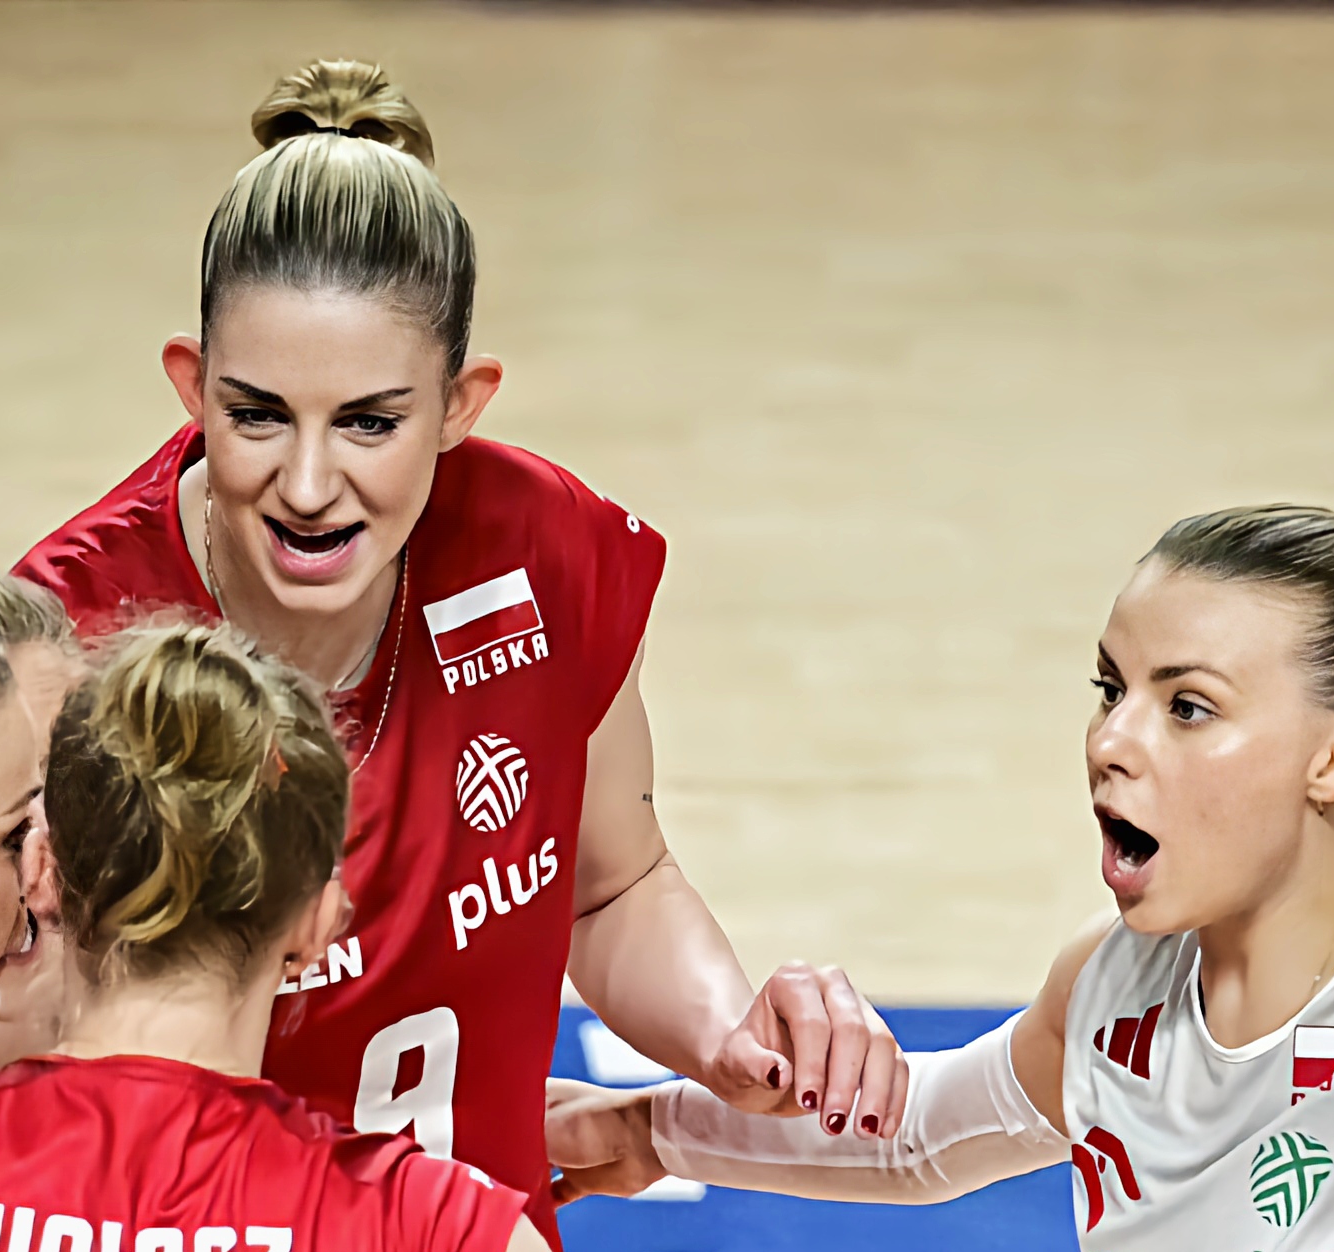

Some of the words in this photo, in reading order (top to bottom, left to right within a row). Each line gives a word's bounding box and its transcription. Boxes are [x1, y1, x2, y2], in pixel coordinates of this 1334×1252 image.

[442, 632, 549, 695] POLSKA
[448, 837, 559, 950] plus
[353, 1006, 460, 1160] 9
